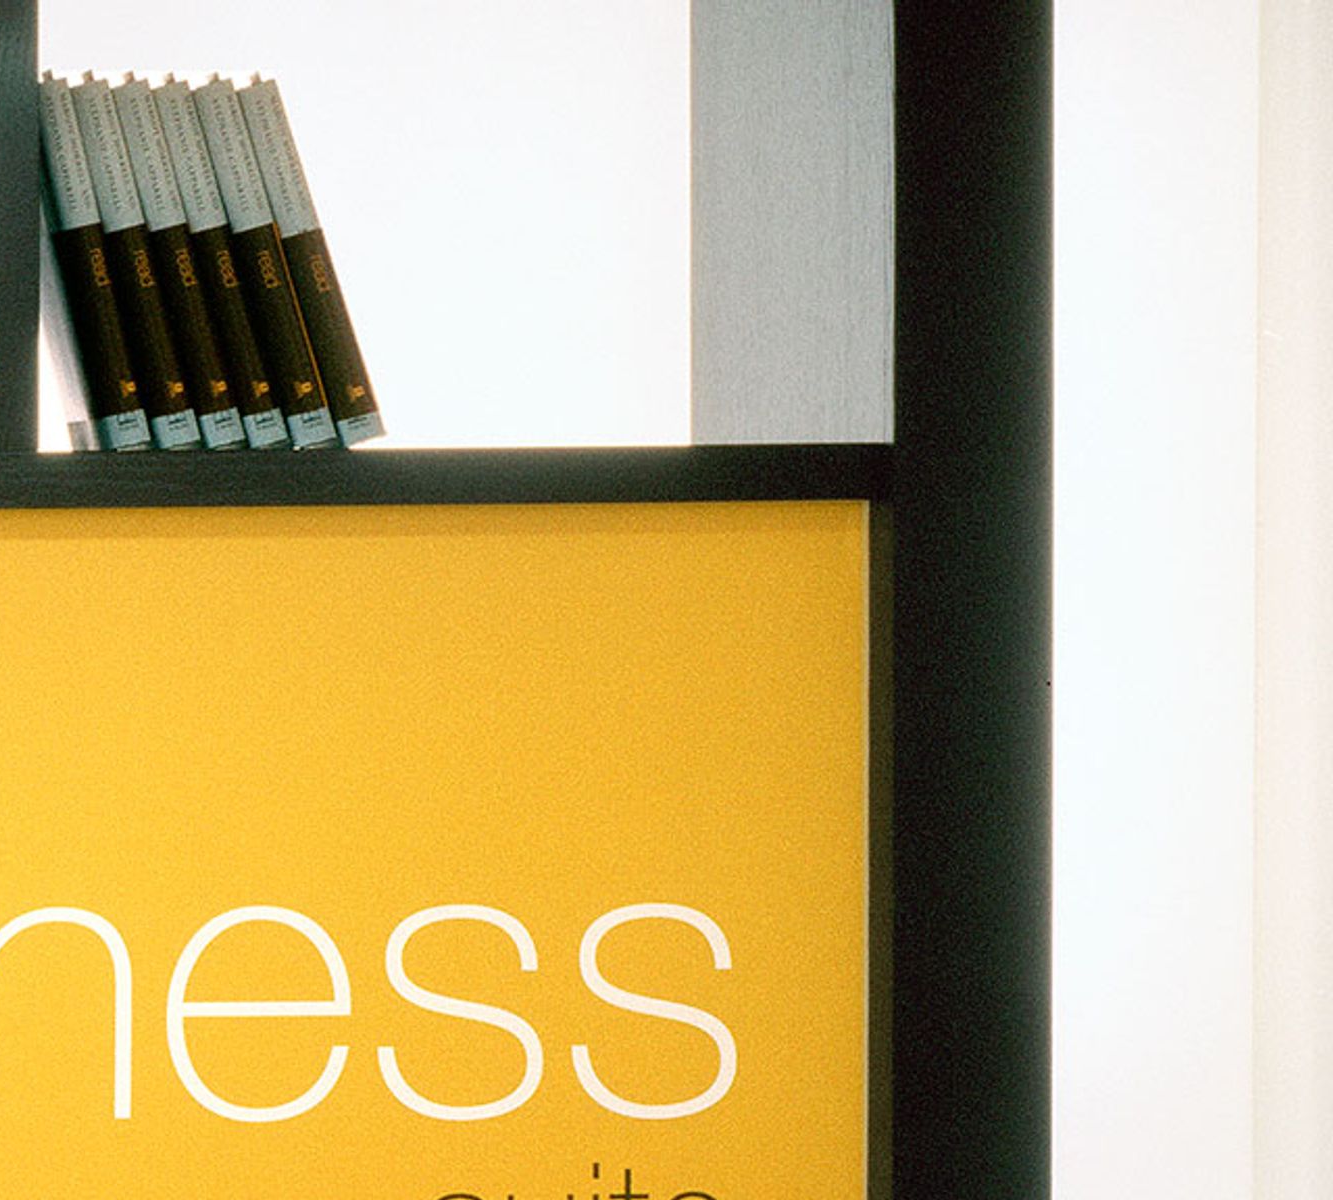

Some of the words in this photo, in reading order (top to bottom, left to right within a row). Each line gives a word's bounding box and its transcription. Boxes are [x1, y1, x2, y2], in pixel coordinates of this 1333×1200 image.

[90, 248, 111, 288] read
[135, 250, 155, 288] read
[175, 249, 198, 288] read
[217, 249, 238, 288] read
[257, 250, 281, 289] read
[311, 254, 331, 292] read
